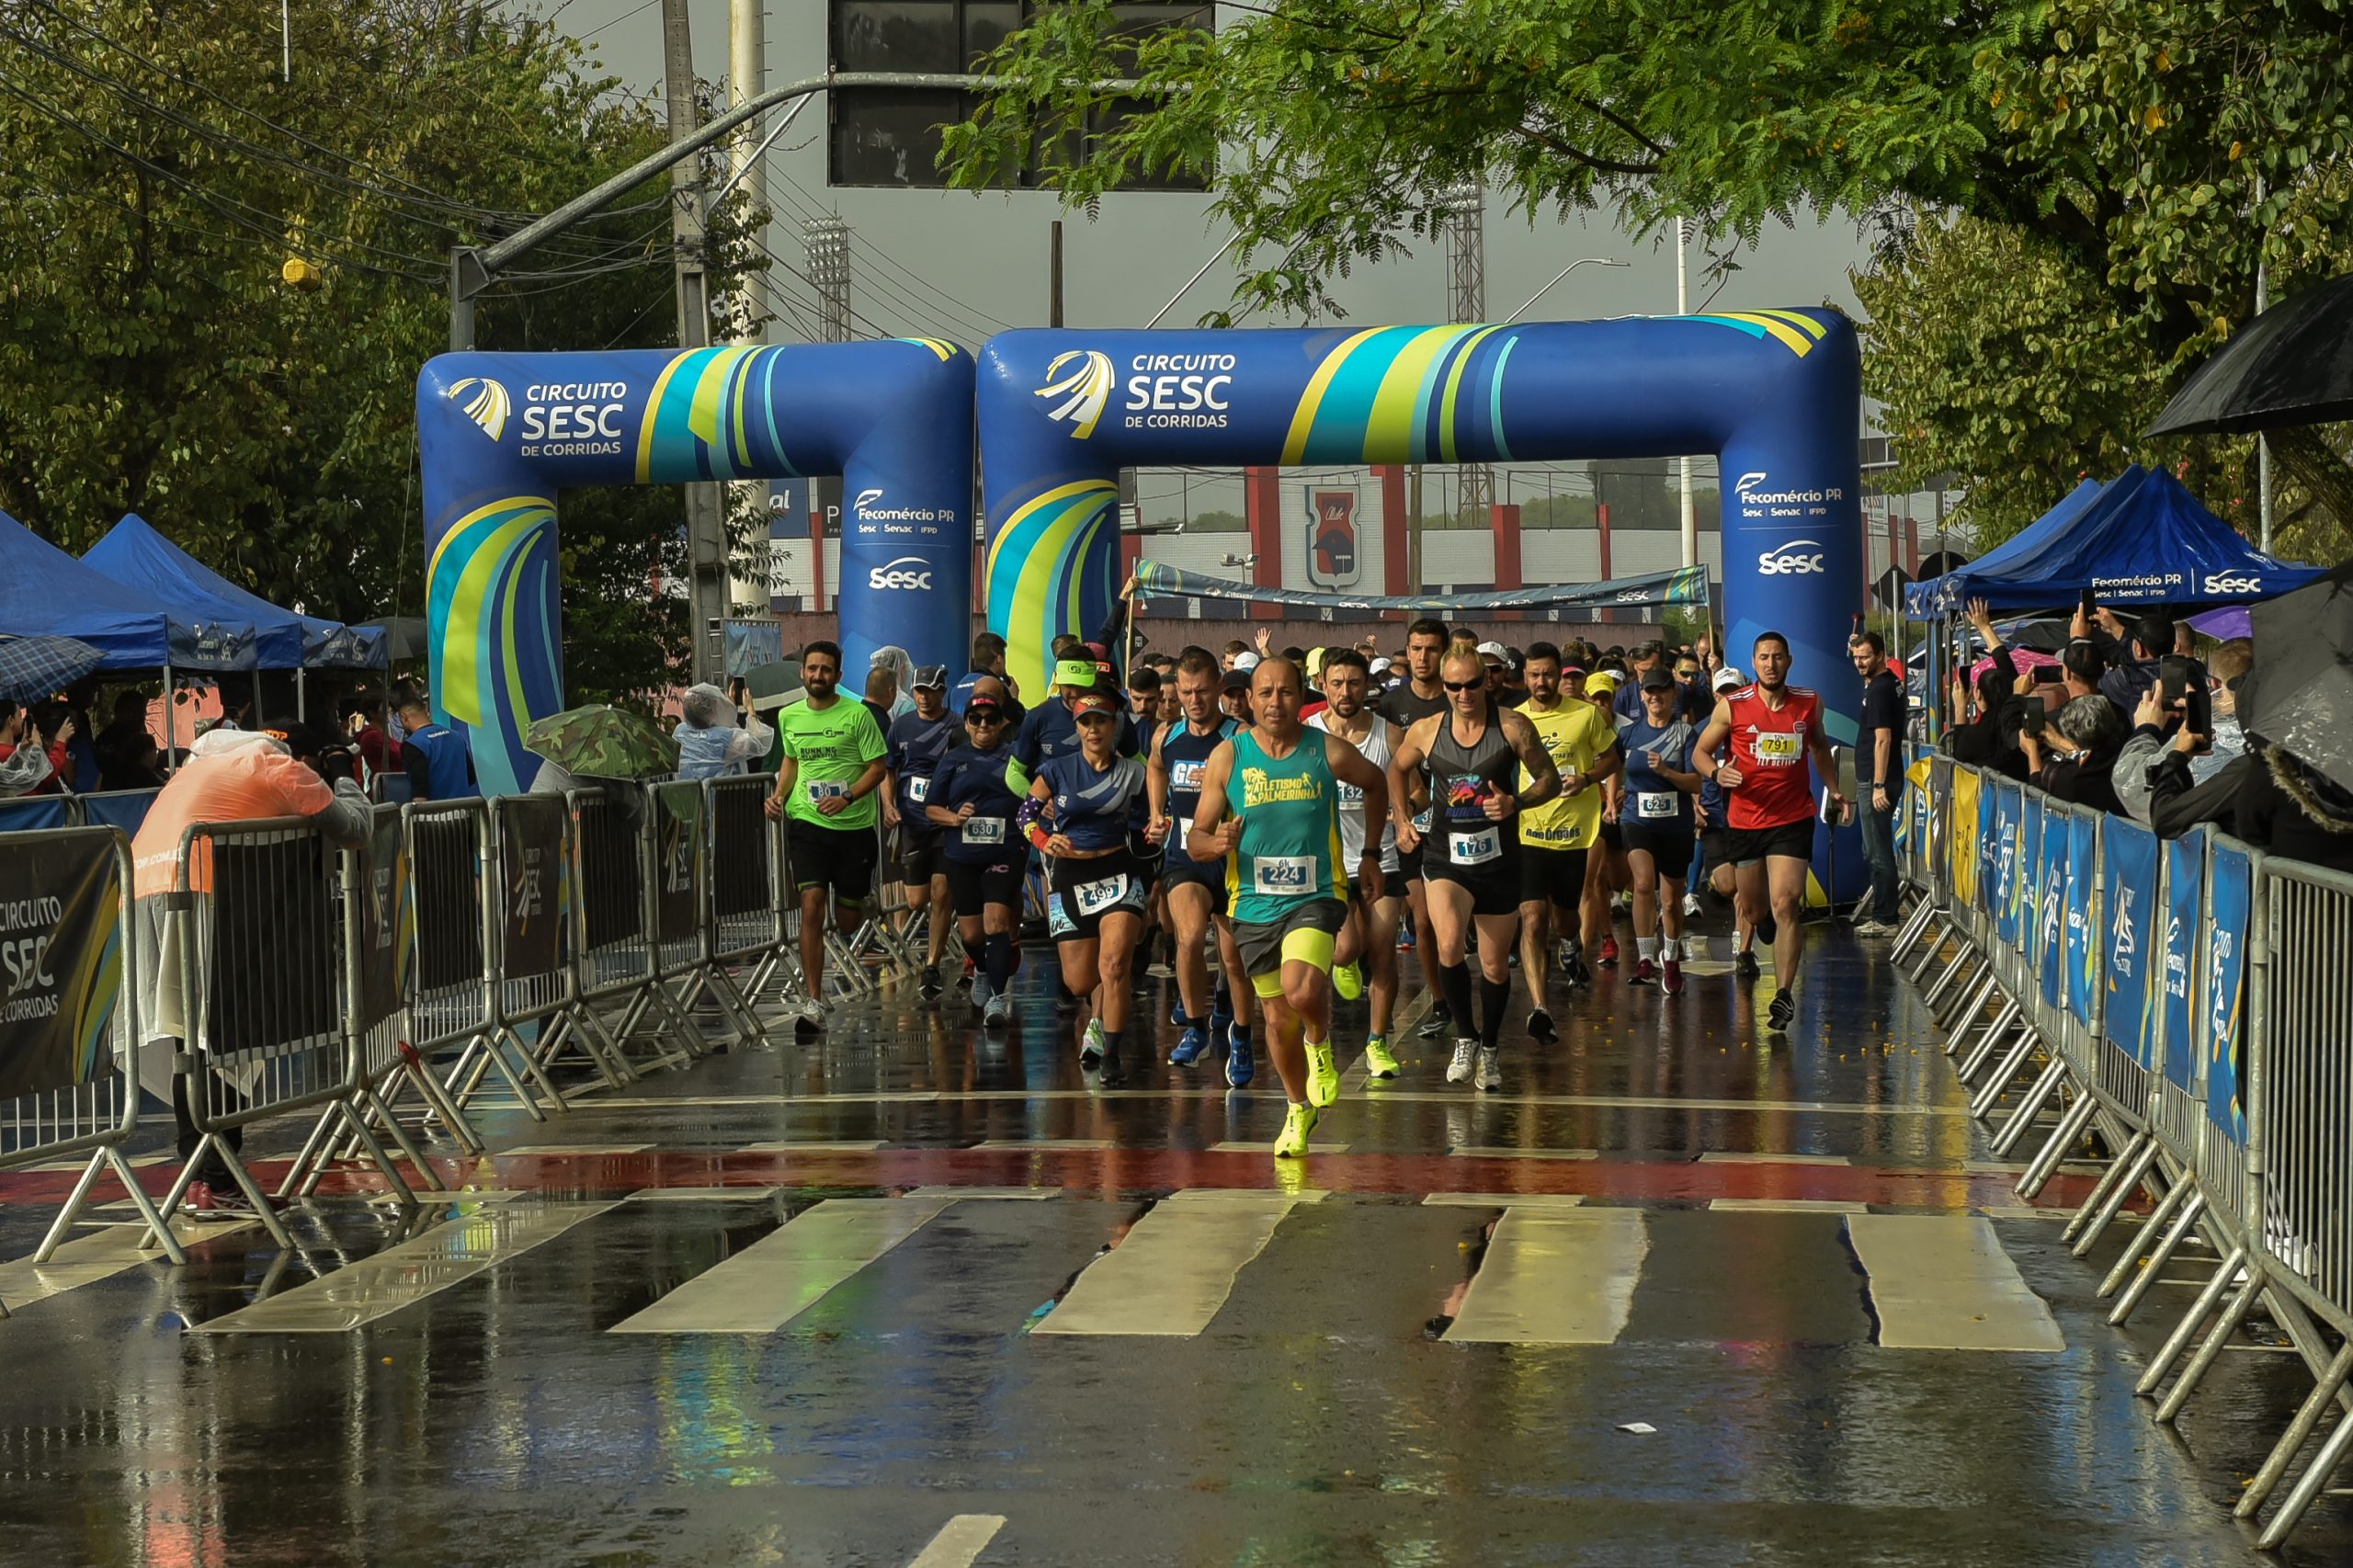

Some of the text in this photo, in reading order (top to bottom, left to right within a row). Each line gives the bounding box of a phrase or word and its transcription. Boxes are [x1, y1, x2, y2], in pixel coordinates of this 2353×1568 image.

[1132, 354, 1236, 371] CIRCUITO
[527, 381, 626, 402] CIRCUITO
[1126, 375, 1232, 410] SESC
[522, 403, 623, 440] SESC
[1125, 415, 1228, 428] DE CORRIDAS
[521, 441, 621, 457] DE CORRIDAS
[1742, 488, 1842, 504] Fecomércio PR
[858, 507, 954, 522] Fecomércio PR
[1743, 508, 1763, 517] Sesc
[1770, 507, 1801, 517] Senac
[858, 524, 938, 535] Sesc Senac IFPD
[1758, 552, 1824, 575] Sesc
[869, 567, 932, 590] Sesc
[2092, 574, 2182, 587] Fecomércio PR
[2204, 575, 2261, 594] Sesc
[1617, 589, 1650, 602] Sesc
[2119, 589, 2143, 597] Senac
[1767, 739, 1789, 751] 791
[818, 786, 831, 798] 80
[1254, 778, 1302, 792] ATLETISMO
[1339, 784, 1363, 800] 132
[1646, 800, 1666, 810] 625
[972, 824, 993, 835] 630
[1462, 839, 1486, 856] 176
[1268, 867, 1301, 881] 224
[1088, 886, 1114, 903] 499
